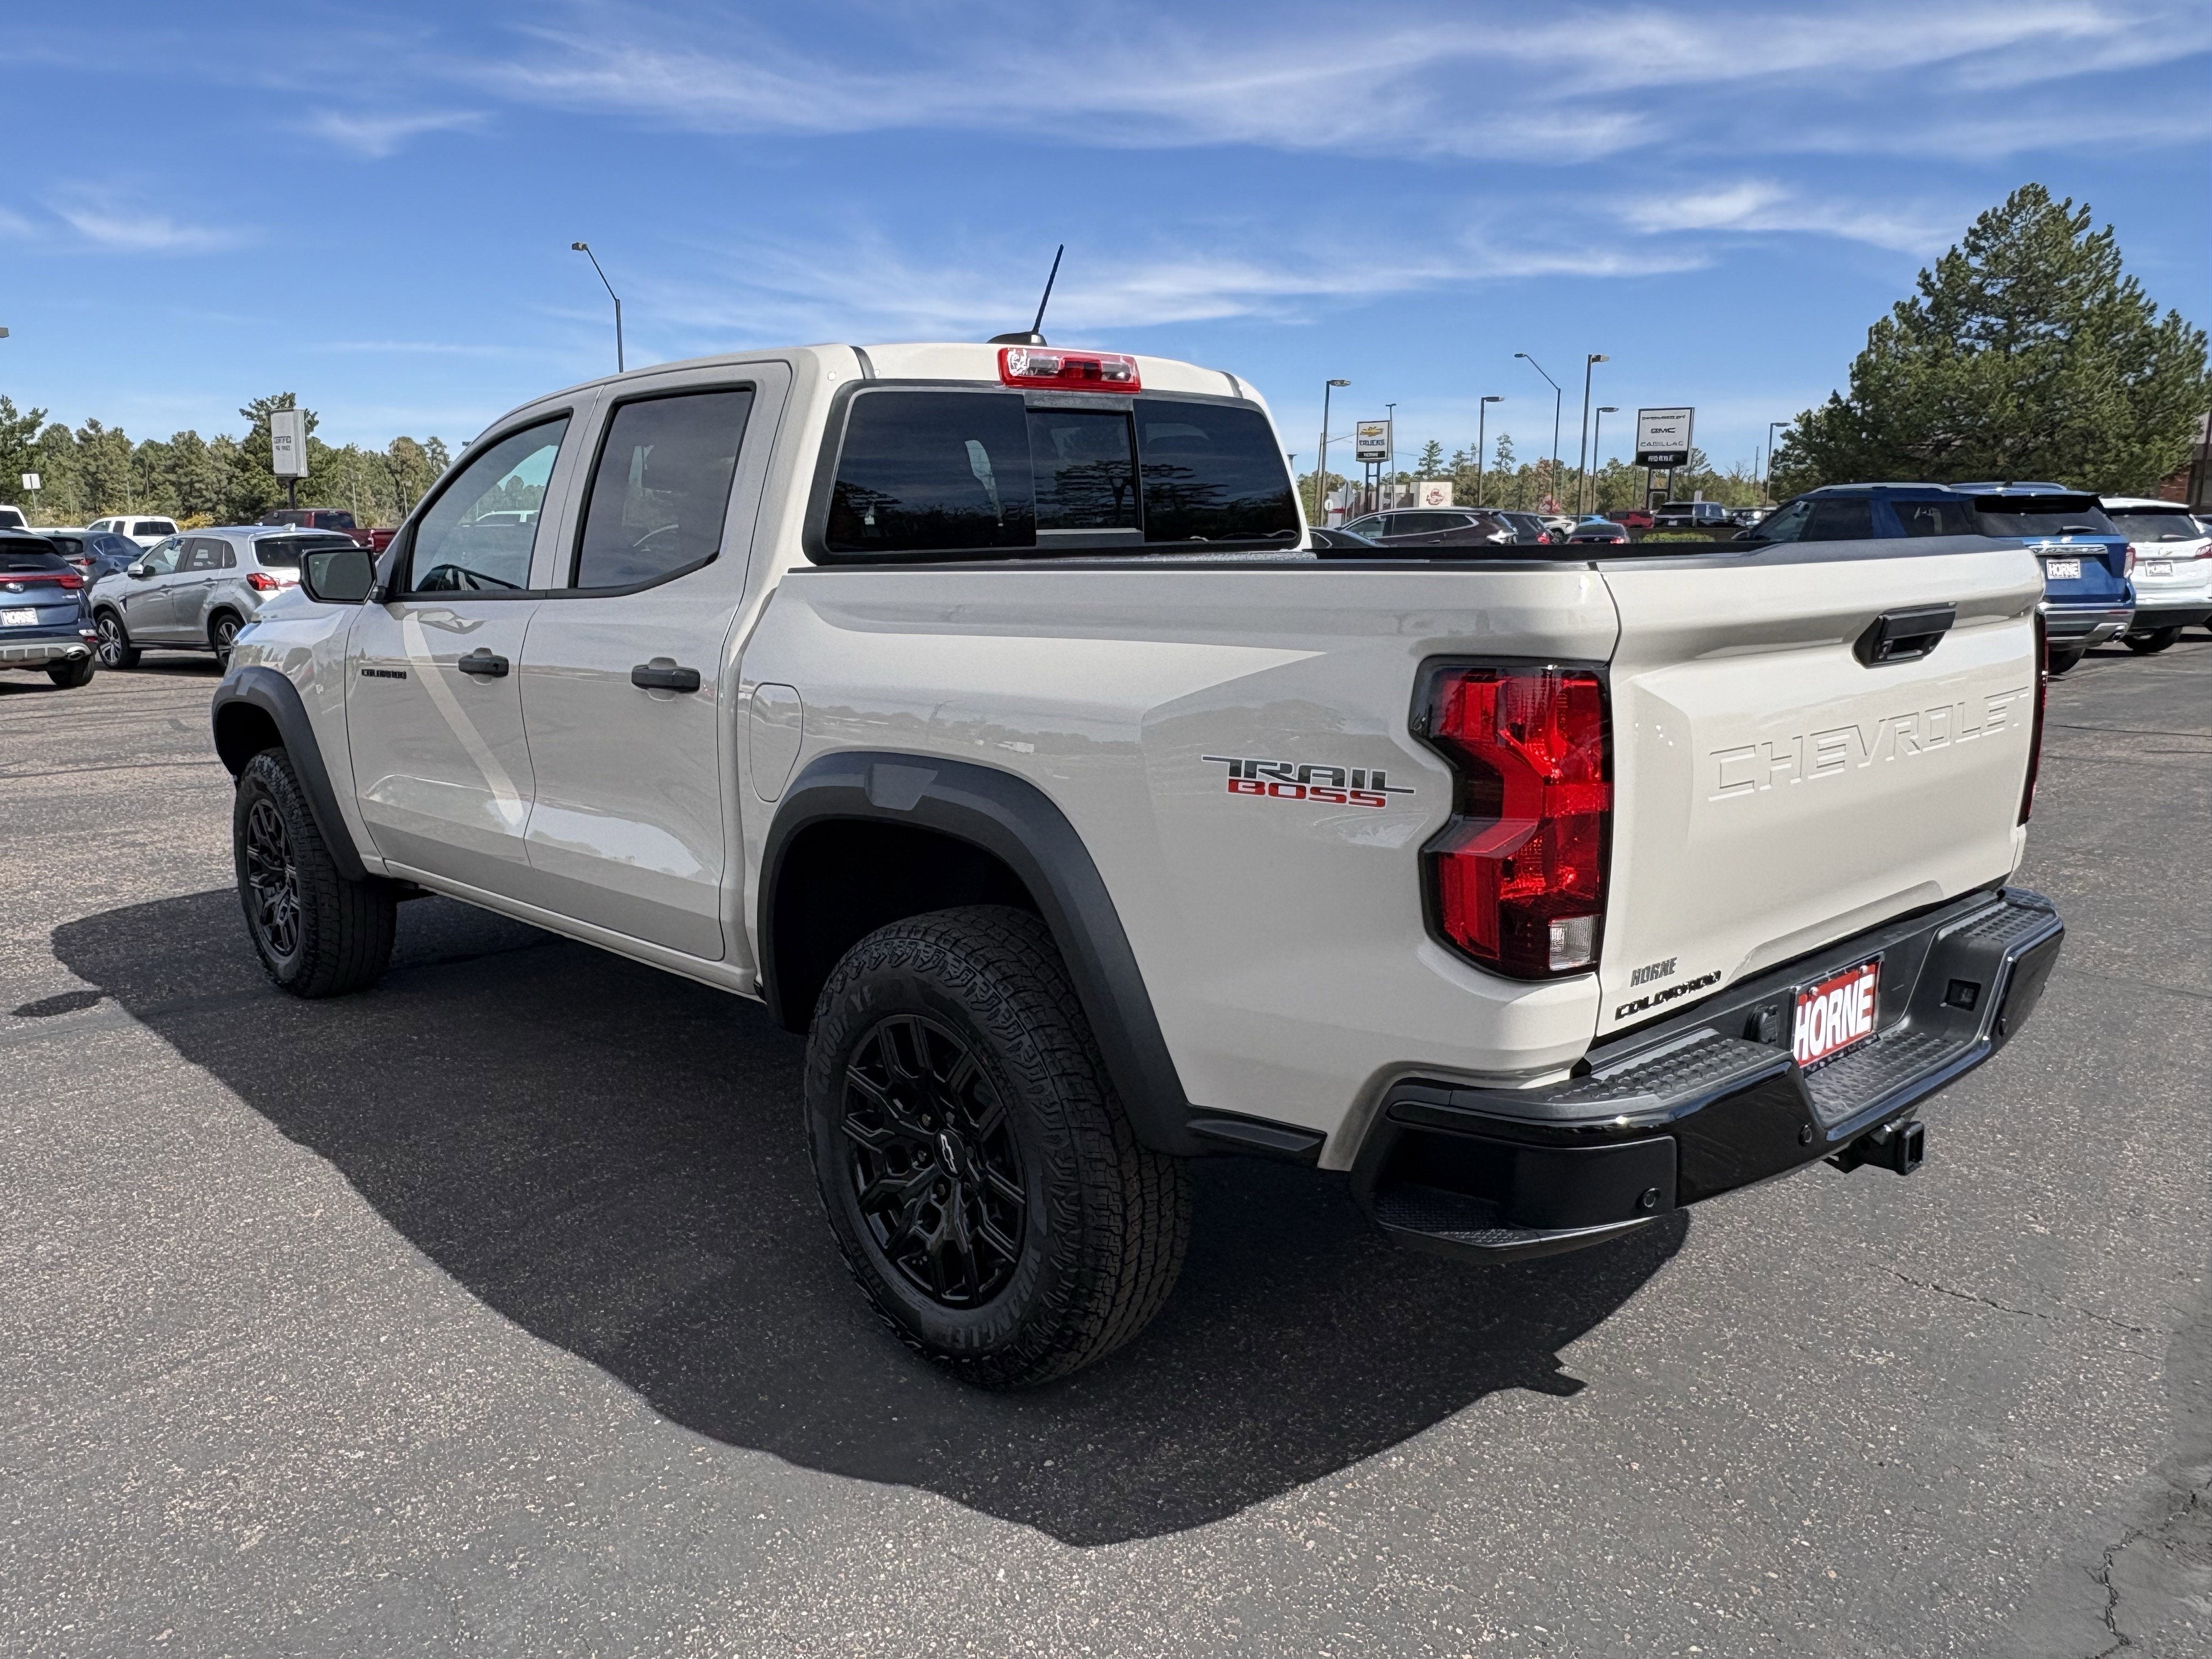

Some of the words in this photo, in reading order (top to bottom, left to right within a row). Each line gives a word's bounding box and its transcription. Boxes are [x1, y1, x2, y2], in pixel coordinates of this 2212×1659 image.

[1201, 755, 1416, 794] TRAIL
[1226, 777, 1387, 809] BOSS
[1630, 957, 1677, 988] HORNE
[1614, 970, 1722, 1021] COLORADO
[1793, 973, 1874, 1061] HORNE
